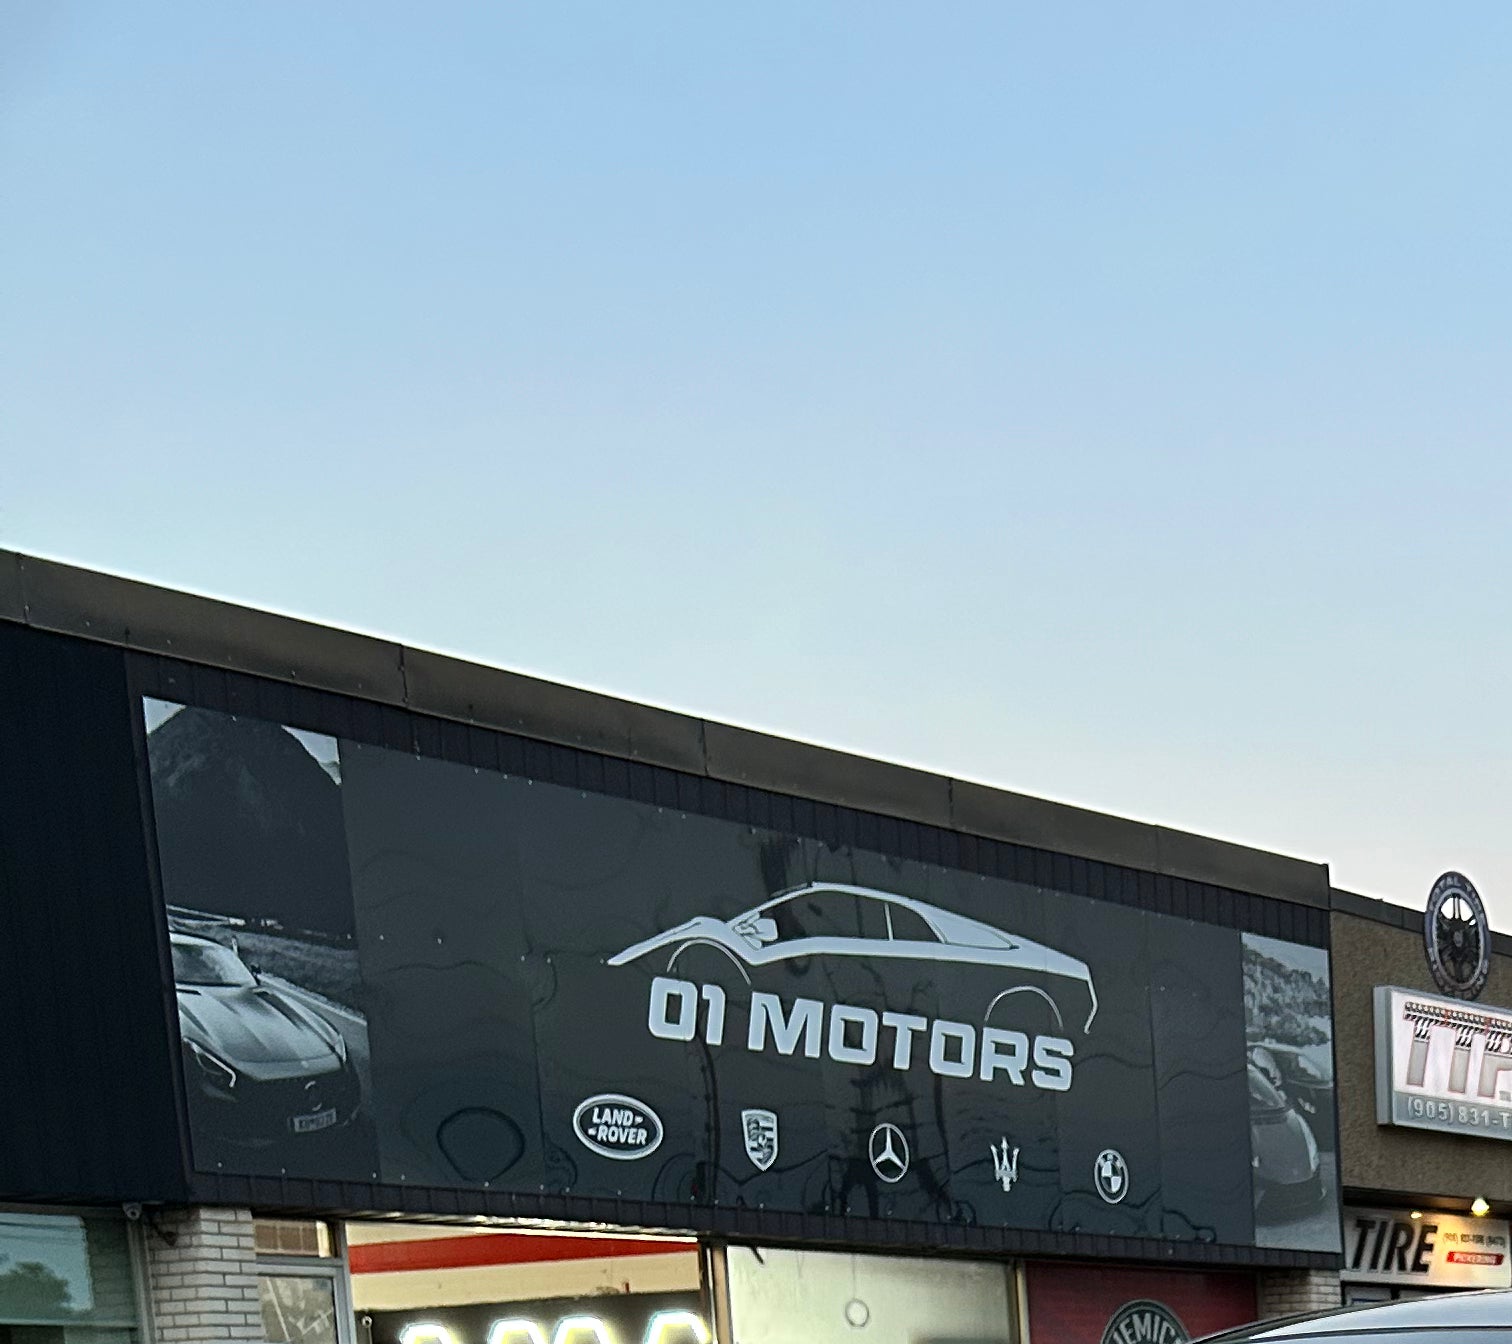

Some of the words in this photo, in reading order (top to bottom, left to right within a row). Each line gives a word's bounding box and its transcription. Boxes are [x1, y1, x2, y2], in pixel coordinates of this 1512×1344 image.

[748, 991, 1074, 1091] MOTORS
[592, 1107, 634, 1127] LAND
[1408, 1096, 1454, 1124] (905)
[597, 1126, 648, 1145] ROVER
[1352, 1219, 1438, 1273] TIRE
